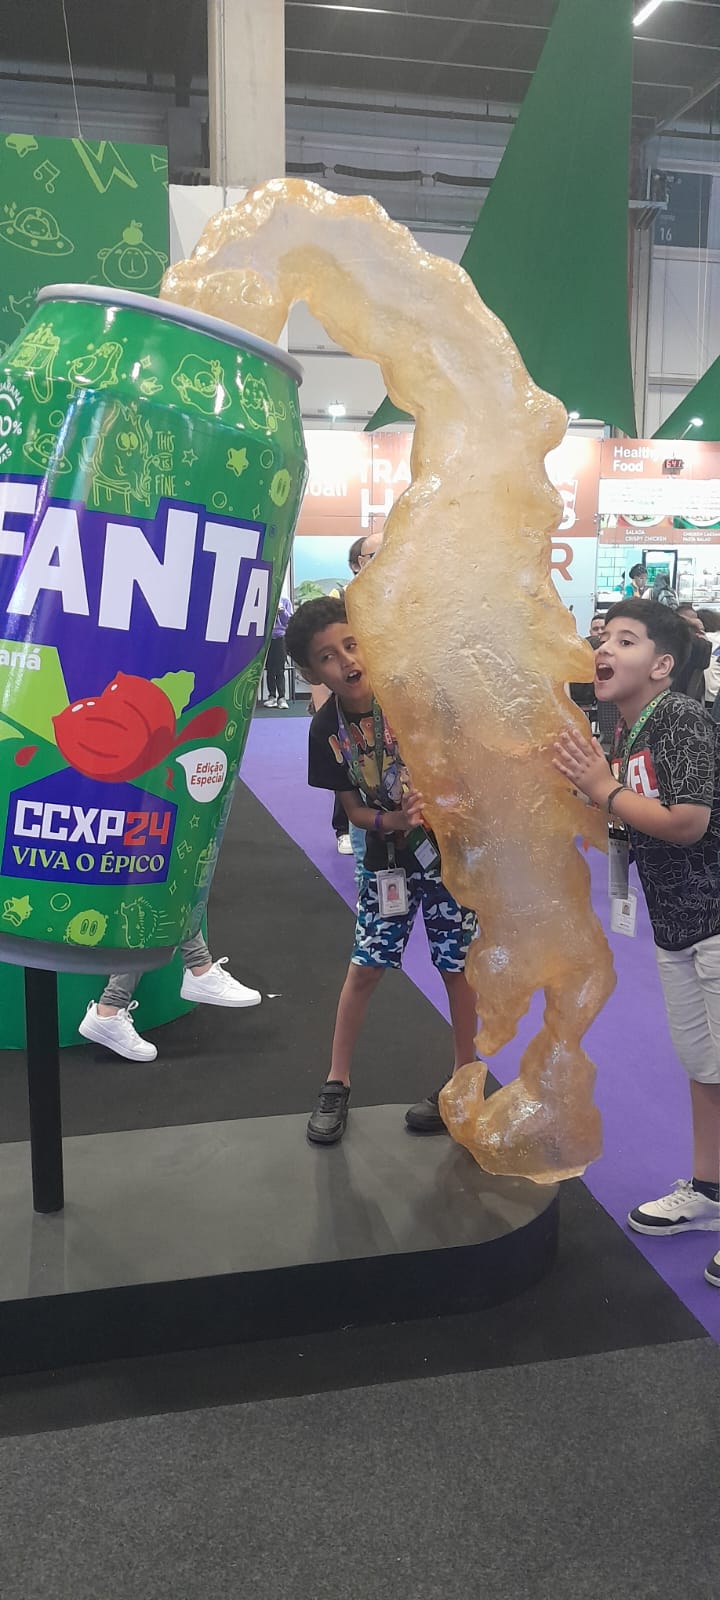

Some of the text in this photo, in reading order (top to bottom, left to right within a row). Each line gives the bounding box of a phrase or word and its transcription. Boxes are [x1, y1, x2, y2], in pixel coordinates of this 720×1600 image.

[660, 226, 673, 241] 16
[613, 460, 644, 473] Food
[0, 482, 269, 643] FANTA
[196, 762, 224, 775] Edição
[191, 772, 224, 787] Especial
[14, 800, 171, 846] CCXP24
[12, 846, 165, 874] VIVA O ÉPICO
